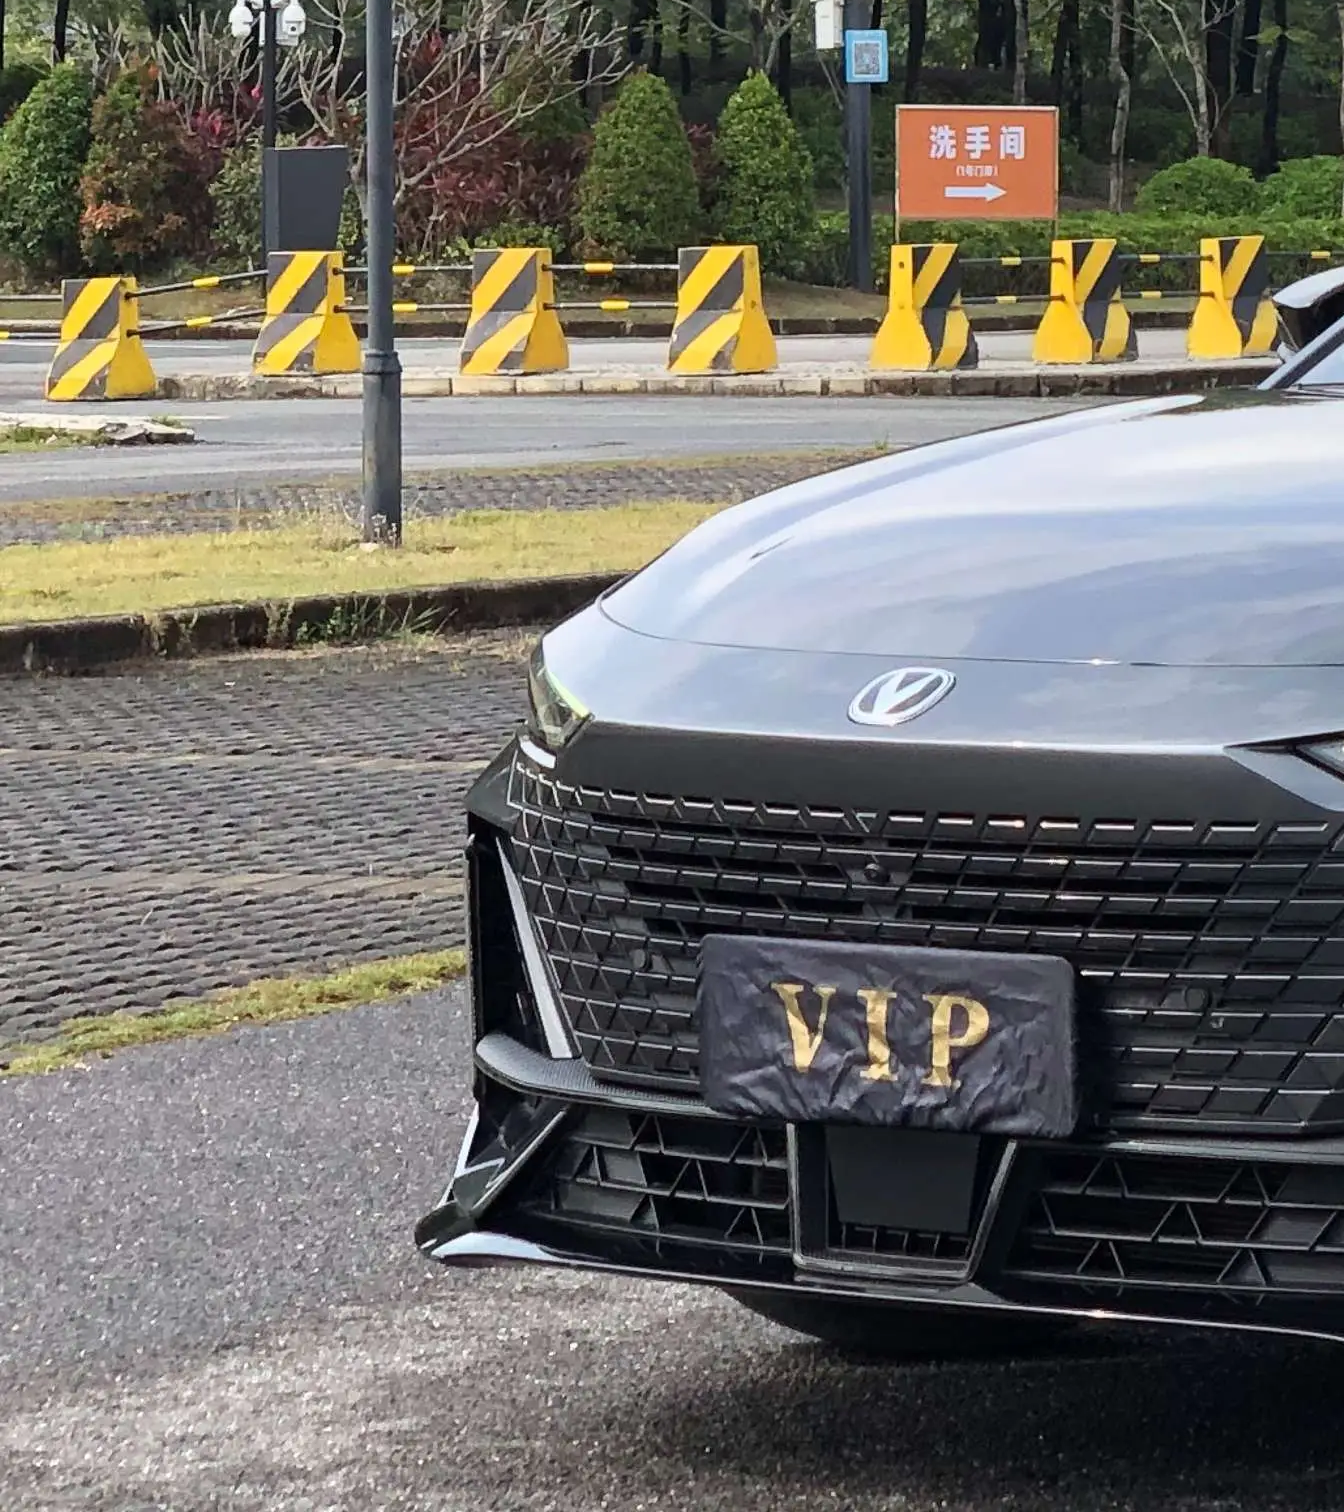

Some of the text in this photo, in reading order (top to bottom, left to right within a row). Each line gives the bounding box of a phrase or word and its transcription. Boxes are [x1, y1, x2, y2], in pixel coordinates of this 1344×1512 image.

[929, 125, 1025, 160] 洗手间
[770, 983, 990, 1090] VIP
